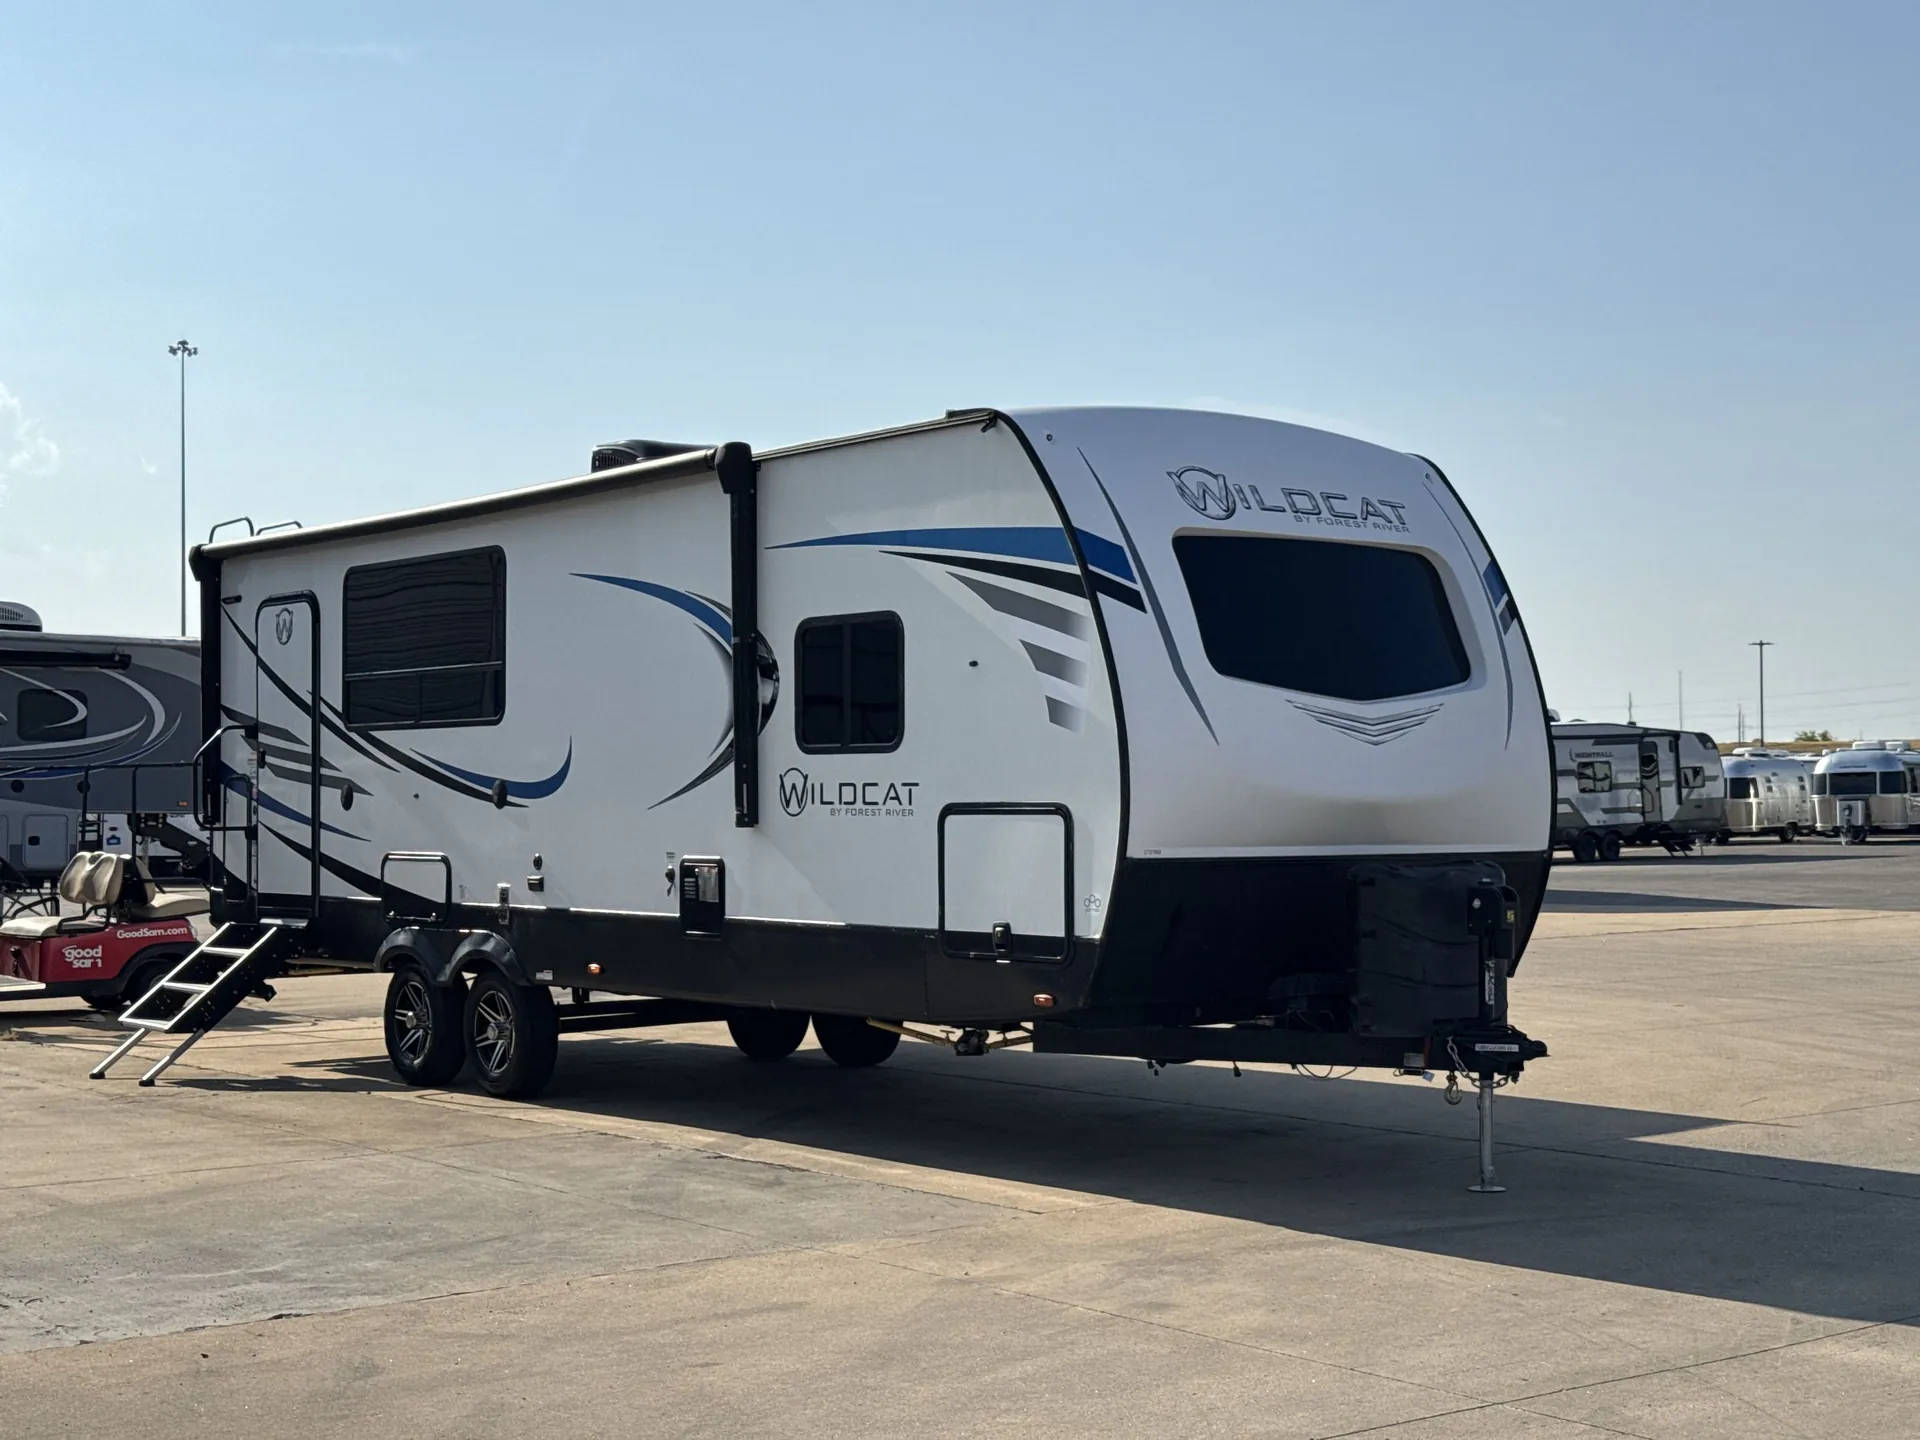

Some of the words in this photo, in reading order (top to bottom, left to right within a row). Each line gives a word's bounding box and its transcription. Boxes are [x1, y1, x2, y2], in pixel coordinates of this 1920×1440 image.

[1166, 466, 1406, 525] WILDCAT
[1293, 515, 1311, 524] BY
[1316, 516, 1368, 529] FOREST
[1373, 522, 1411, 534] RIVER
[779, 767, 920, 817] WILDCAT
[830, 808, 842, 817] BY
[845, 808, 882, 817] FOREST
[885, 809, 914, 817] RIVER
[117, 927, 187, 939] GoodSam.com
[62, 944, 102, 961] good
